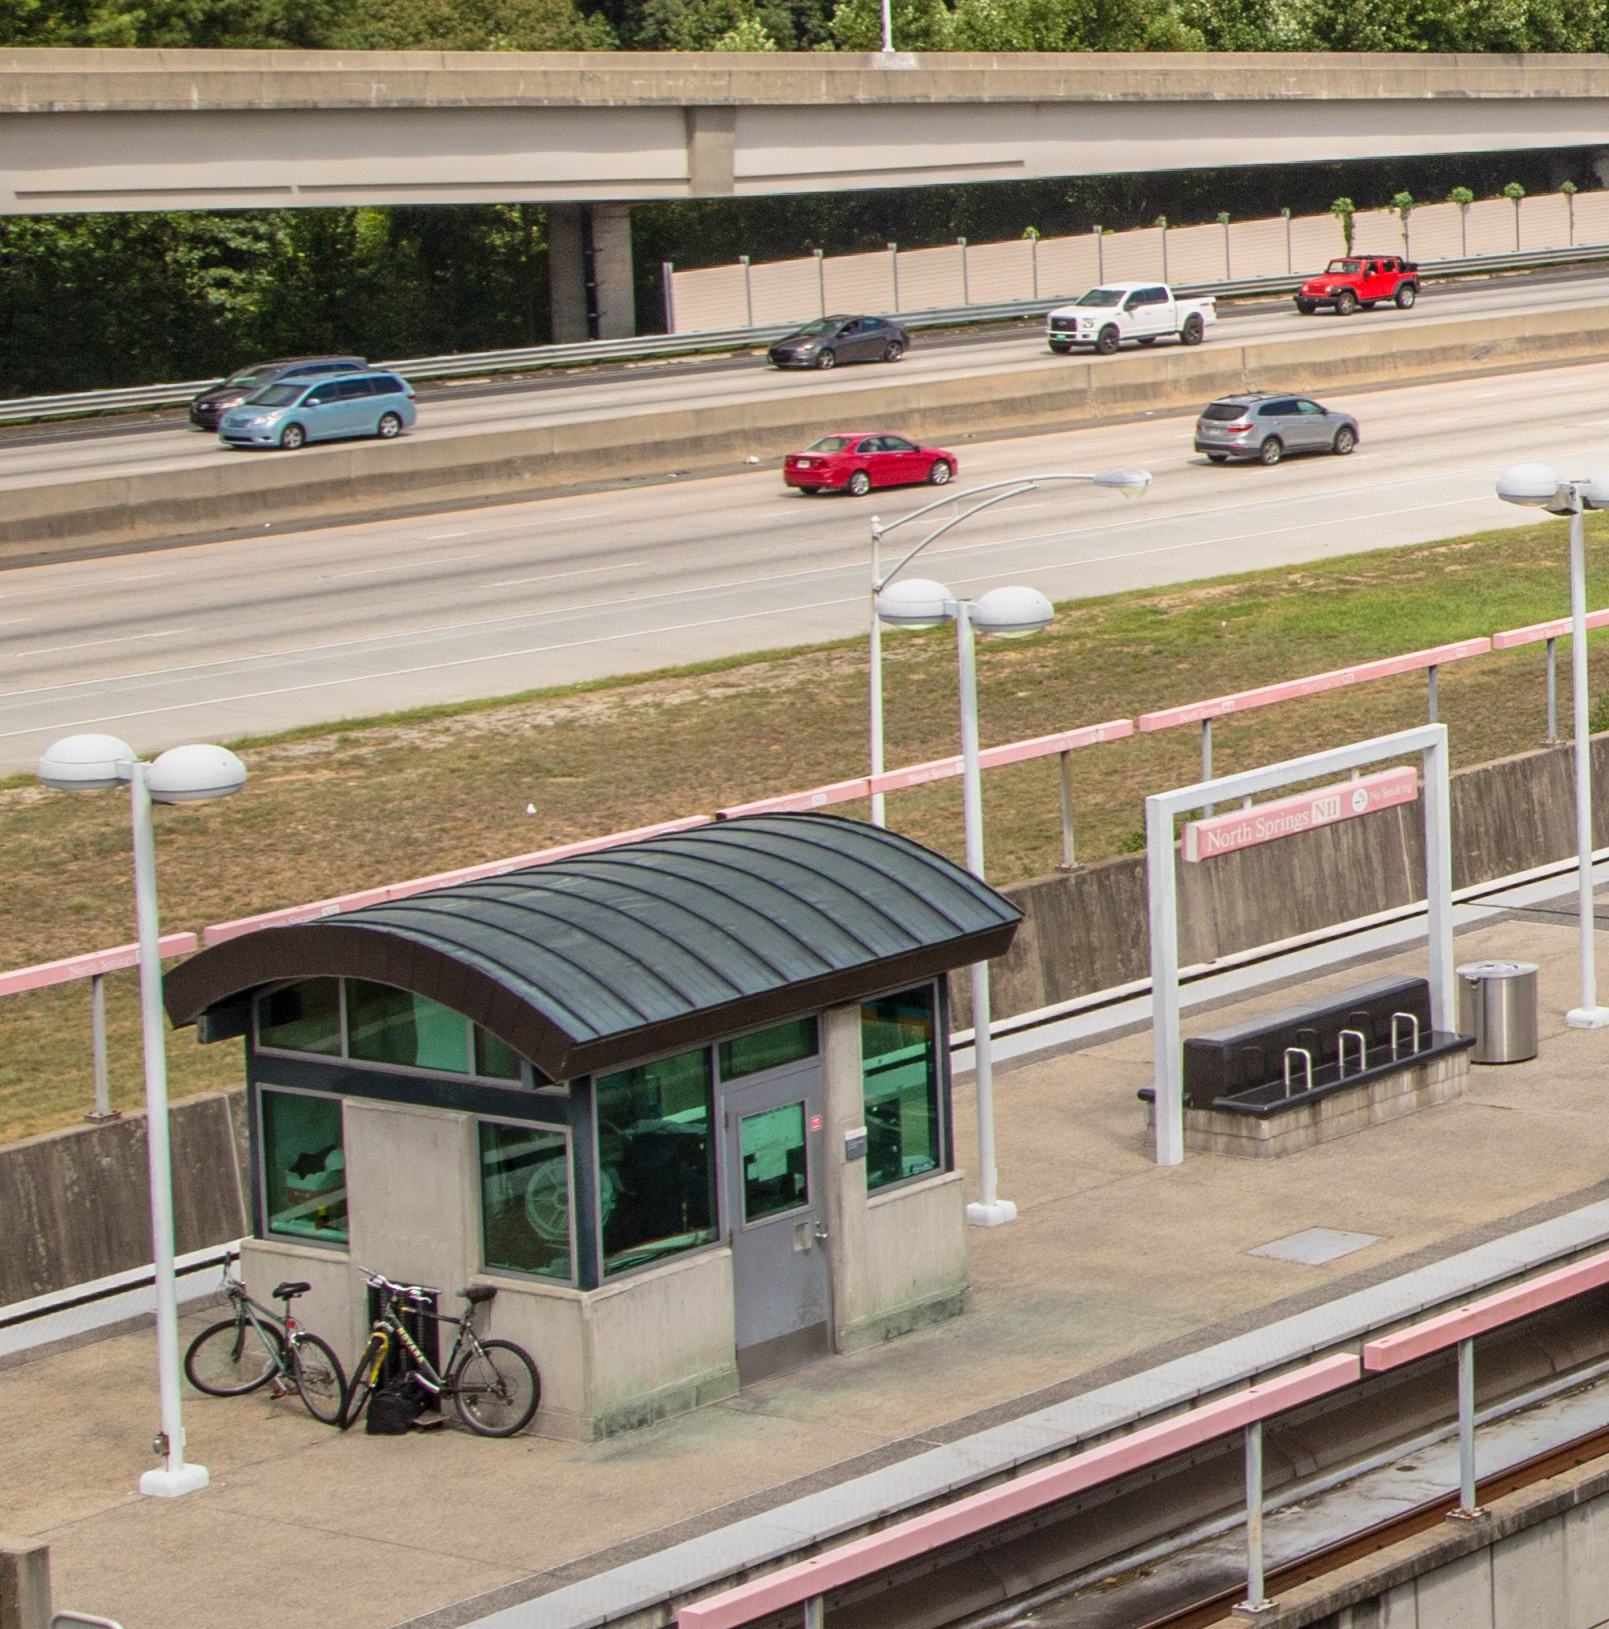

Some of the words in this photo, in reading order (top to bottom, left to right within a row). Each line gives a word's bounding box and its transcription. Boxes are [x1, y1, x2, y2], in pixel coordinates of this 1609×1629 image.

[1207, 825, 1251, 852] North
[1256, 810, 1309, 842] Springs
[1314, 797, 1338, 820] N11
[1370, 790, 1381, 801] No
[1382, 783, 1413, 799] Smoking
